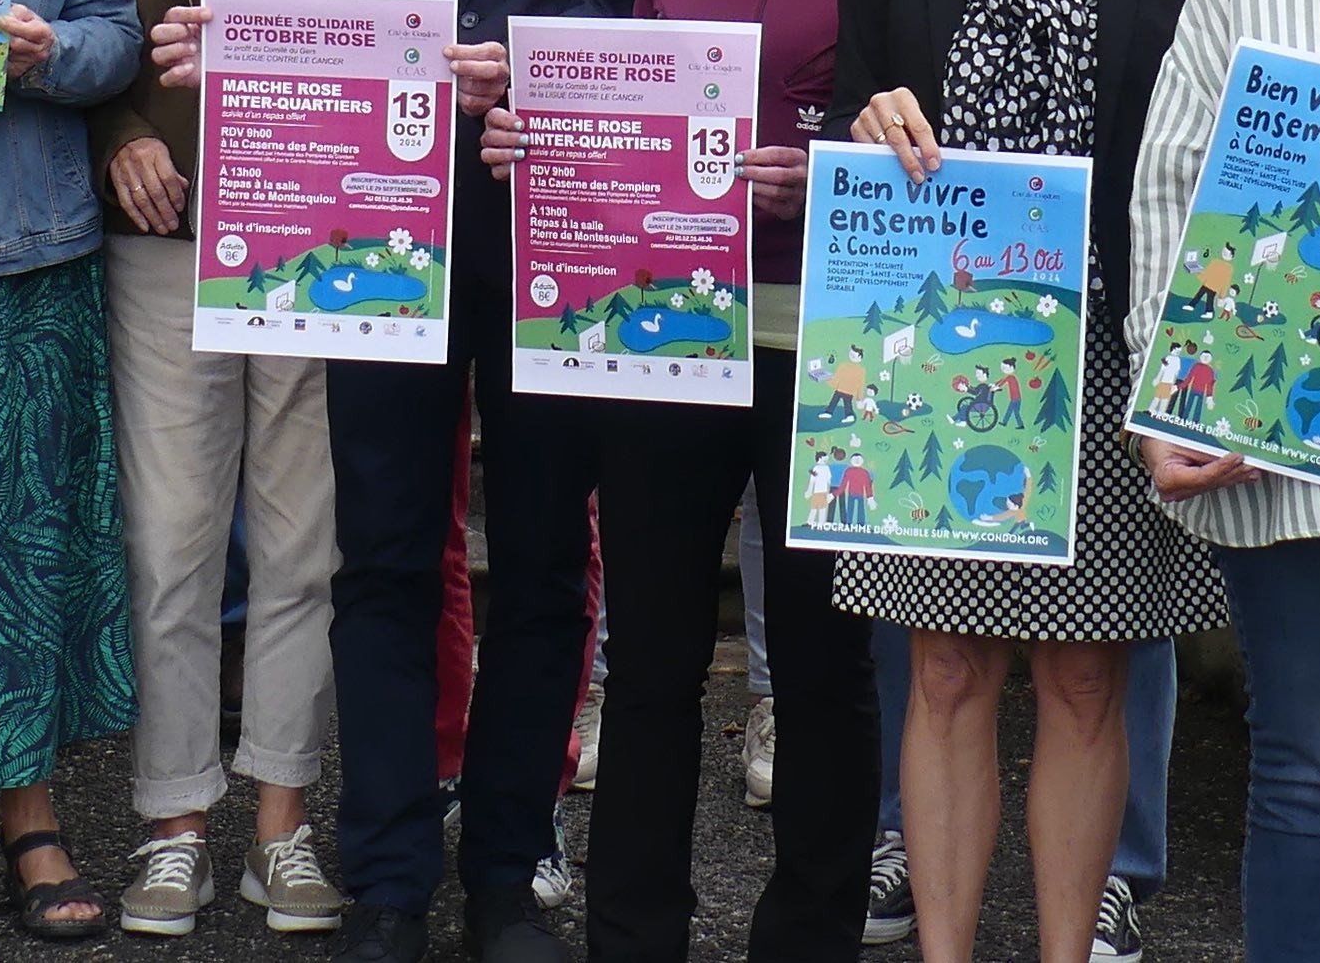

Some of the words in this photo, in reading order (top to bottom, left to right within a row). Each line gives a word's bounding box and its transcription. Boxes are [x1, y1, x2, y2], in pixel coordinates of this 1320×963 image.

[224, 14, 293, 27] JOURNÉE
[297, 17, 375, 31] SOLIDAIRE
[225, 28, 317, 45] OCTOBRE
[324, 32, 376, 47] ROSE
[529, 49, 595, 63] JOURNÉE
[599, 53, 675, 65] SOLIDAIRE
[529, 65, 617, 81] OCTOBRE
[625, 68, 676, 83] ROSE
[223, 79, 293, 95] MARCHE
[297, 82, 342, 97] ROSE
[1246, 65, 1298, 105] Bien
[223, 95, 373, 114] INTER-QUARTIERS
[393, 91, 431, 119] 13
[697, 101, 727, 113] CCAS
[393, 123, 429, 137] OCT
[529, 117, 593, 132] MARCHE
[598, 120, 642, 134] ROSE
[399, 139, 421, 147] 2024
[530, 133, 672, 151] INTER-QUARTIERS
[693, 129, 729, 157] 13
[1230, 132, 1239, 151] à
[1245, 135, 1307, 165] Condom
[693, 161, 730, 175] OCT
[701, 177, 722, 185] 2024
[833, 167, 893, 201] Bien
[906, 177, 987, 207] vivre
[219, 189, 249, 201] Pierre
[253, 191, 265, 201] de
[267, 191, 337, 205] Montesquiou
[218, 221, 244, 233] Droit
[246, 223, 311, 236] d'inscription
[829, 208, 988, 238] ensemble
[530, 229, 558, 241] Pierre
[561, 231, 573, 241] de
[575, 231, 639, 245] Montesquiou
[829, 236, 841, 253] à
[847, 237, 918, 257] Condom
[828, 259, 869, 268] PRÉVENTION
[875, 261, 903, 270] SÉCURITÉ
[953, 239, 970, 271] 6
[975, 254, 995, 269] au
[997, 242, 1029, 277] 13
[531, 261, 553, 273] Droit
[556, 263, 617, 277] d'inscription
[827, 267, 864, 275] SOLIDARITÉ
[871, 271, 891, 279] SANTÉ
[1032, 272, 1061, 283] 2024
[826, 283, 855, 291] DURABLE
[827, 275, 848, 283] SPORT
[854, 277, 909, 287] DÉVELOPPEMENT
[1149, 411, 1203, 435] PROGRAMME
[1205, 425, 1259, 447] DISPONIBLE
[1261, 441, 1281, 453] SUR
[811, 522, 872, 534] PROGRAMME
[873, 525, 929, 538] DISPONIBLE
[931, 529, 949, 539] SUR
[952, 530, 1049, 546] WWW.CONDOM.ORG
